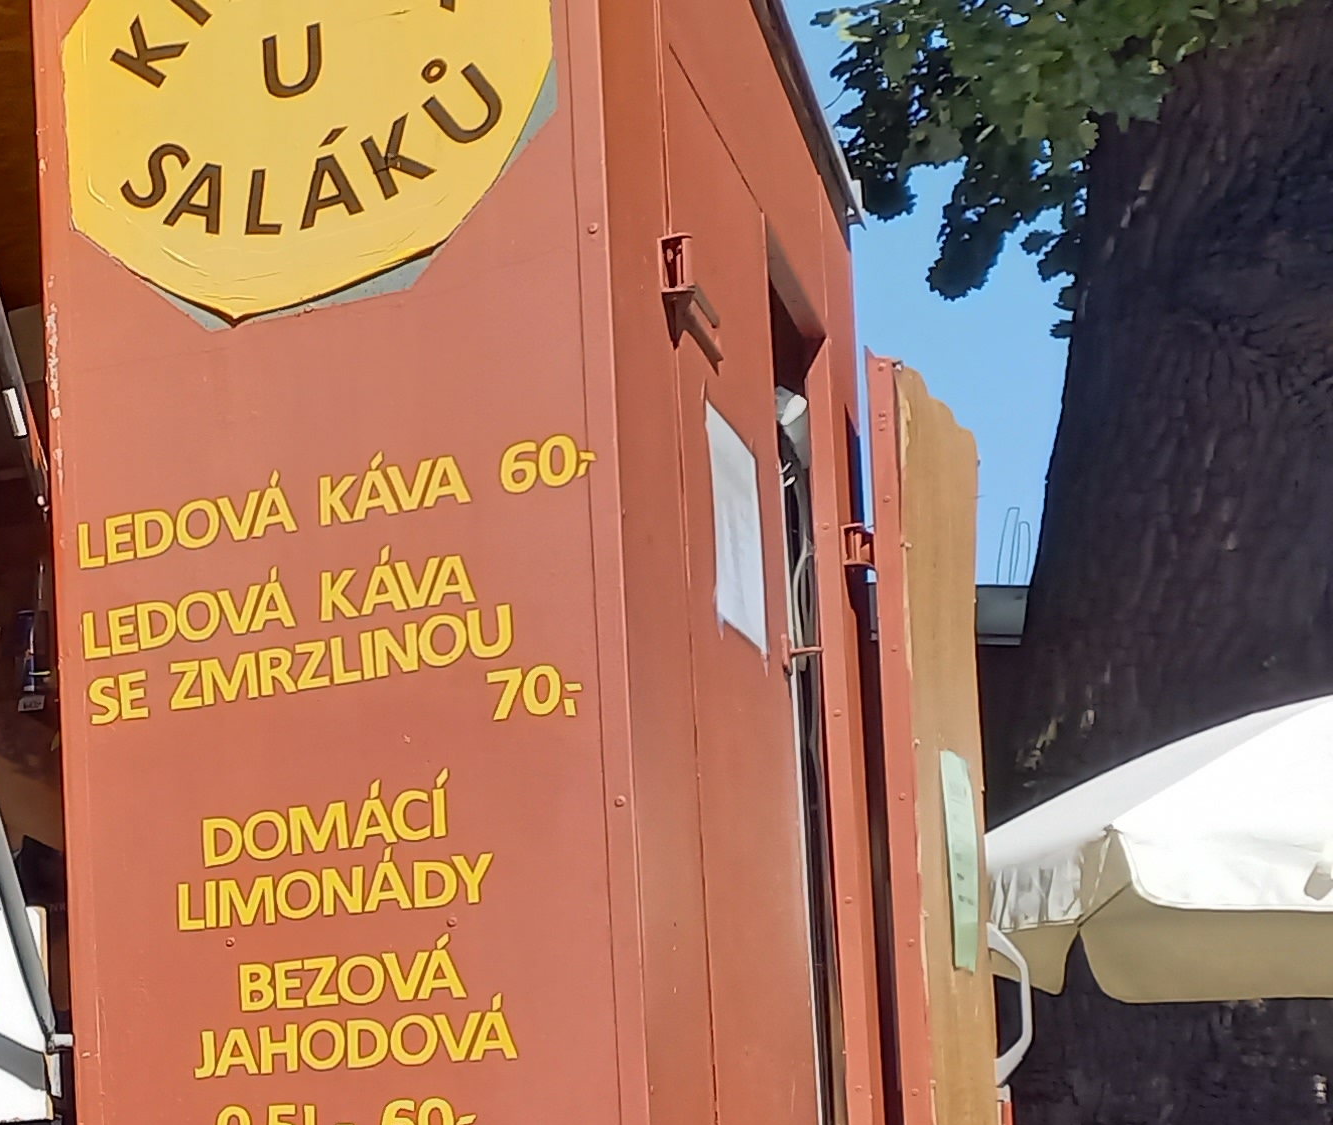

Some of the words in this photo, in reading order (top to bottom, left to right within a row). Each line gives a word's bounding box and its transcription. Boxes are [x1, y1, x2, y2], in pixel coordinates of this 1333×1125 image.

[262, 22, 321, 98] U
[121, 57, 502, 236] SALÁKŮ
[77, 470, 298, 569] LEDOVÁ
[319, 451, 472, 527] KÁVA
[499, 434, 597, 495] 60,-
[82, 565, 296, 660] LEDOVÁ
[320, 545, 476, 623] KÁVA
[89, 671, 149, 725] SE
[169, 603, 514, 711] ZMRZLINOU
[486, 665, 583, 722] 70,-
[201, 768, 449, 867] DOMÁCÍ
[177, 847, 493, 931] LIMONÁDY
[239, 933, 467, 1012] BEZOVÁ
[194, 993, 518, 1079] JAHODOVÁ
